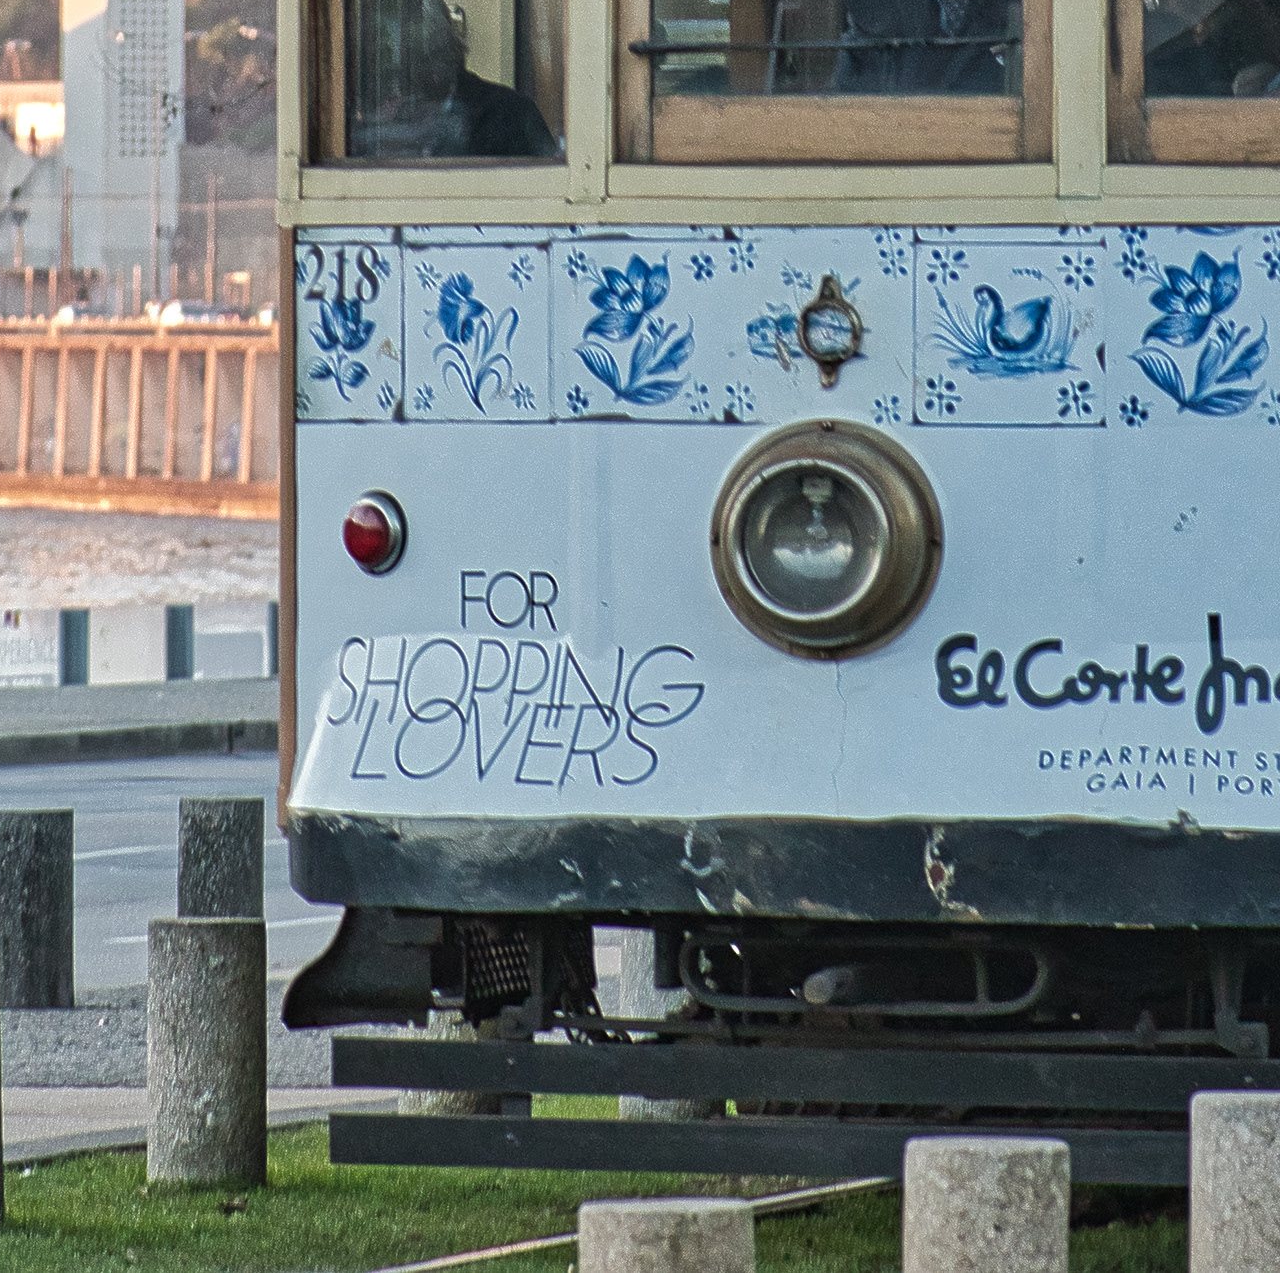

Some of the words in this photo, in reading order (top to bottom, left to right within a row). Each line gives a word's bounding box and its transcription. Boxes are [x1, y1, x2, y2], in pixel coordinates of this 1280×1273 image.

[303, 242, 380, 303] 218
[460, 570, 559, 631] FOR
[326, 636, 705, 728] SHOPPING
[934, 632, 1009, 709] El
[1013, 638, 1187, 710] Corte
[350, 697, 659, 790] LOVERS
[1038, 746, 1239, 770] DEPARTMENT
[1086, 771, 1167, 794] GAIA
